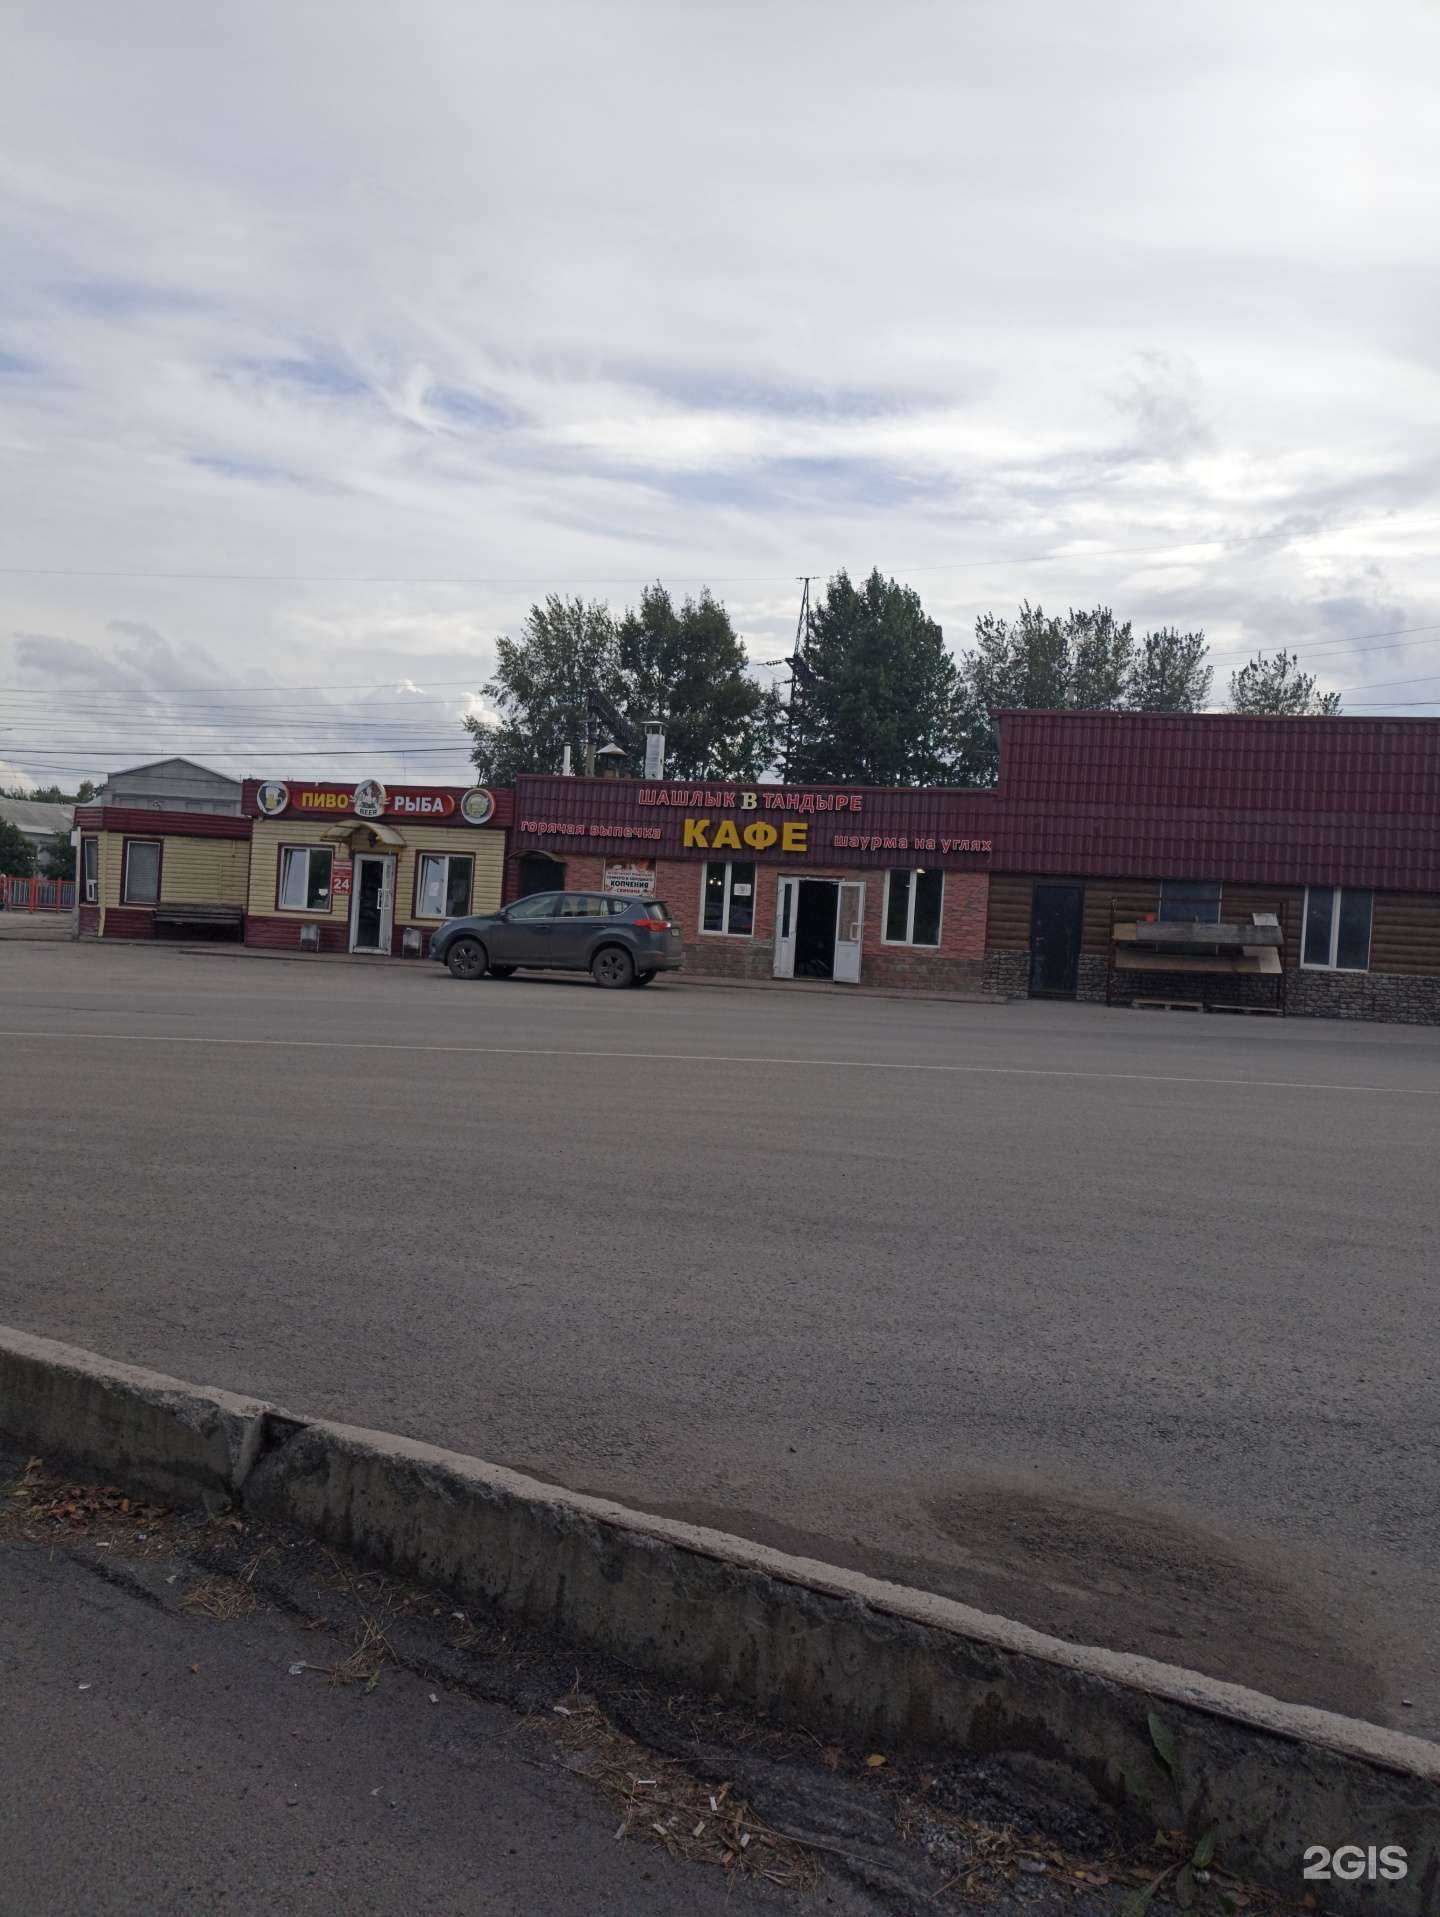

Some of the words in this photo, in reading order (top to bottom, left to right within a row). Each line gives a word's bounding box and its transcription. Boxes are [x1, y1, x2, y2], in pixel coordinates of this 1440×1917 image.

[302, 792, 348, 808] ПИВО
[394, 796, 444, 812] РЫБА
[638, 789, 736, 807] ШАШЛЫК
[740, 792, 758, 810] В
[763, 793, 863, 814] ТАНДЫРЕ
[360, 808, 377, 816] BEER
[521, 820, 585, 836] горячая
[590, 824, 662, 839] выпечка
[683, 818, 808, 852] КАФЕ
[834, 835, 908, 851] шаурма
[914, 837, 936, 849] на
[941, 839, 992, 853] углях
[335, 878, 350, 890] 24
[610, 880, 649, 888] КОПЧЕНИЯ
